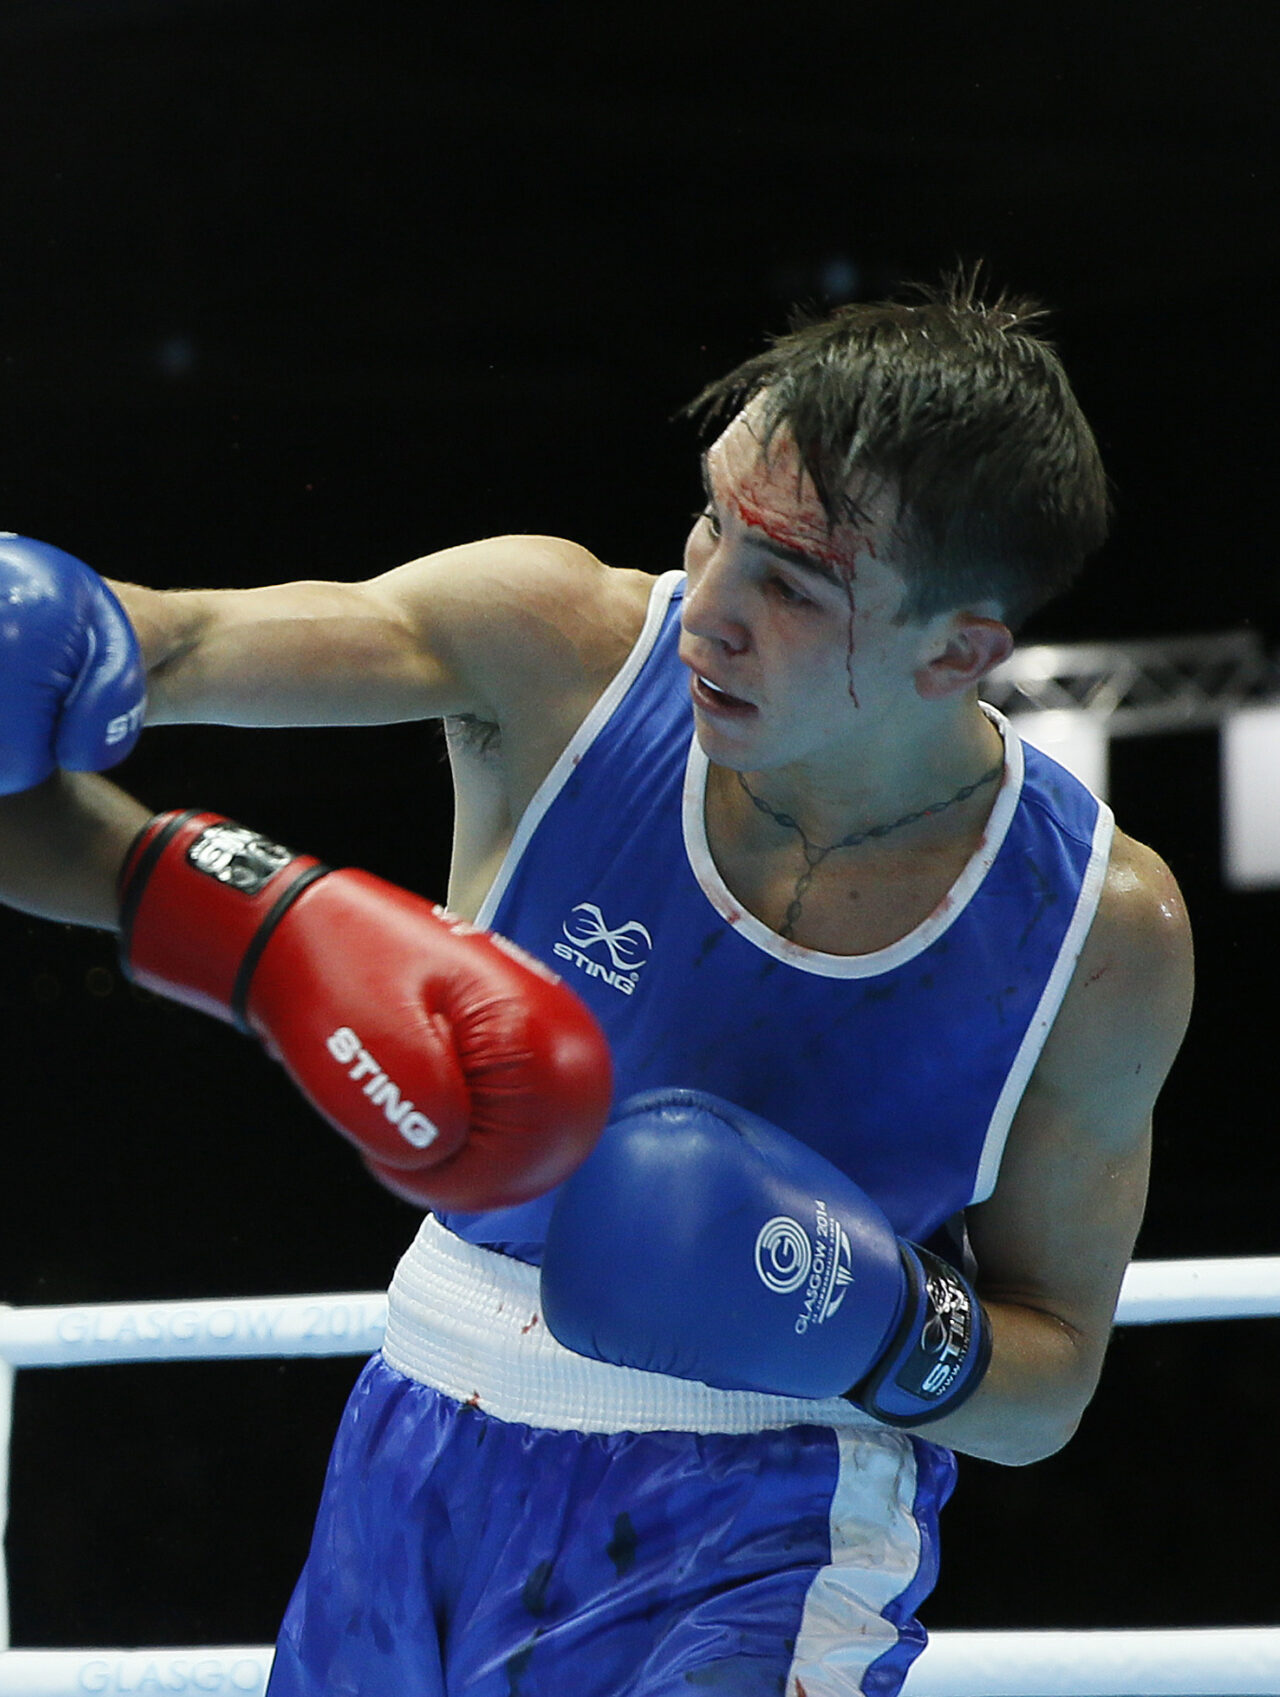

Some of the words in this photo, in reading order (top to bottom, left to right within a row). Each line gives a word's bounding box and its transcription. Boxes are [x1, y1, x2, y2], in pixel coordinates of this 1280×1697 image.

[553, 942, 637, 996] STING
[326, 1027, 439, 1148] STING
[794, 1241, 827, 1335] GLASGOW
[815, 1199, 829, 1240] 2014
[58, 1308, 286, 1343] GLASGOW
[78, 1656, 266, 1694] GLASGO
